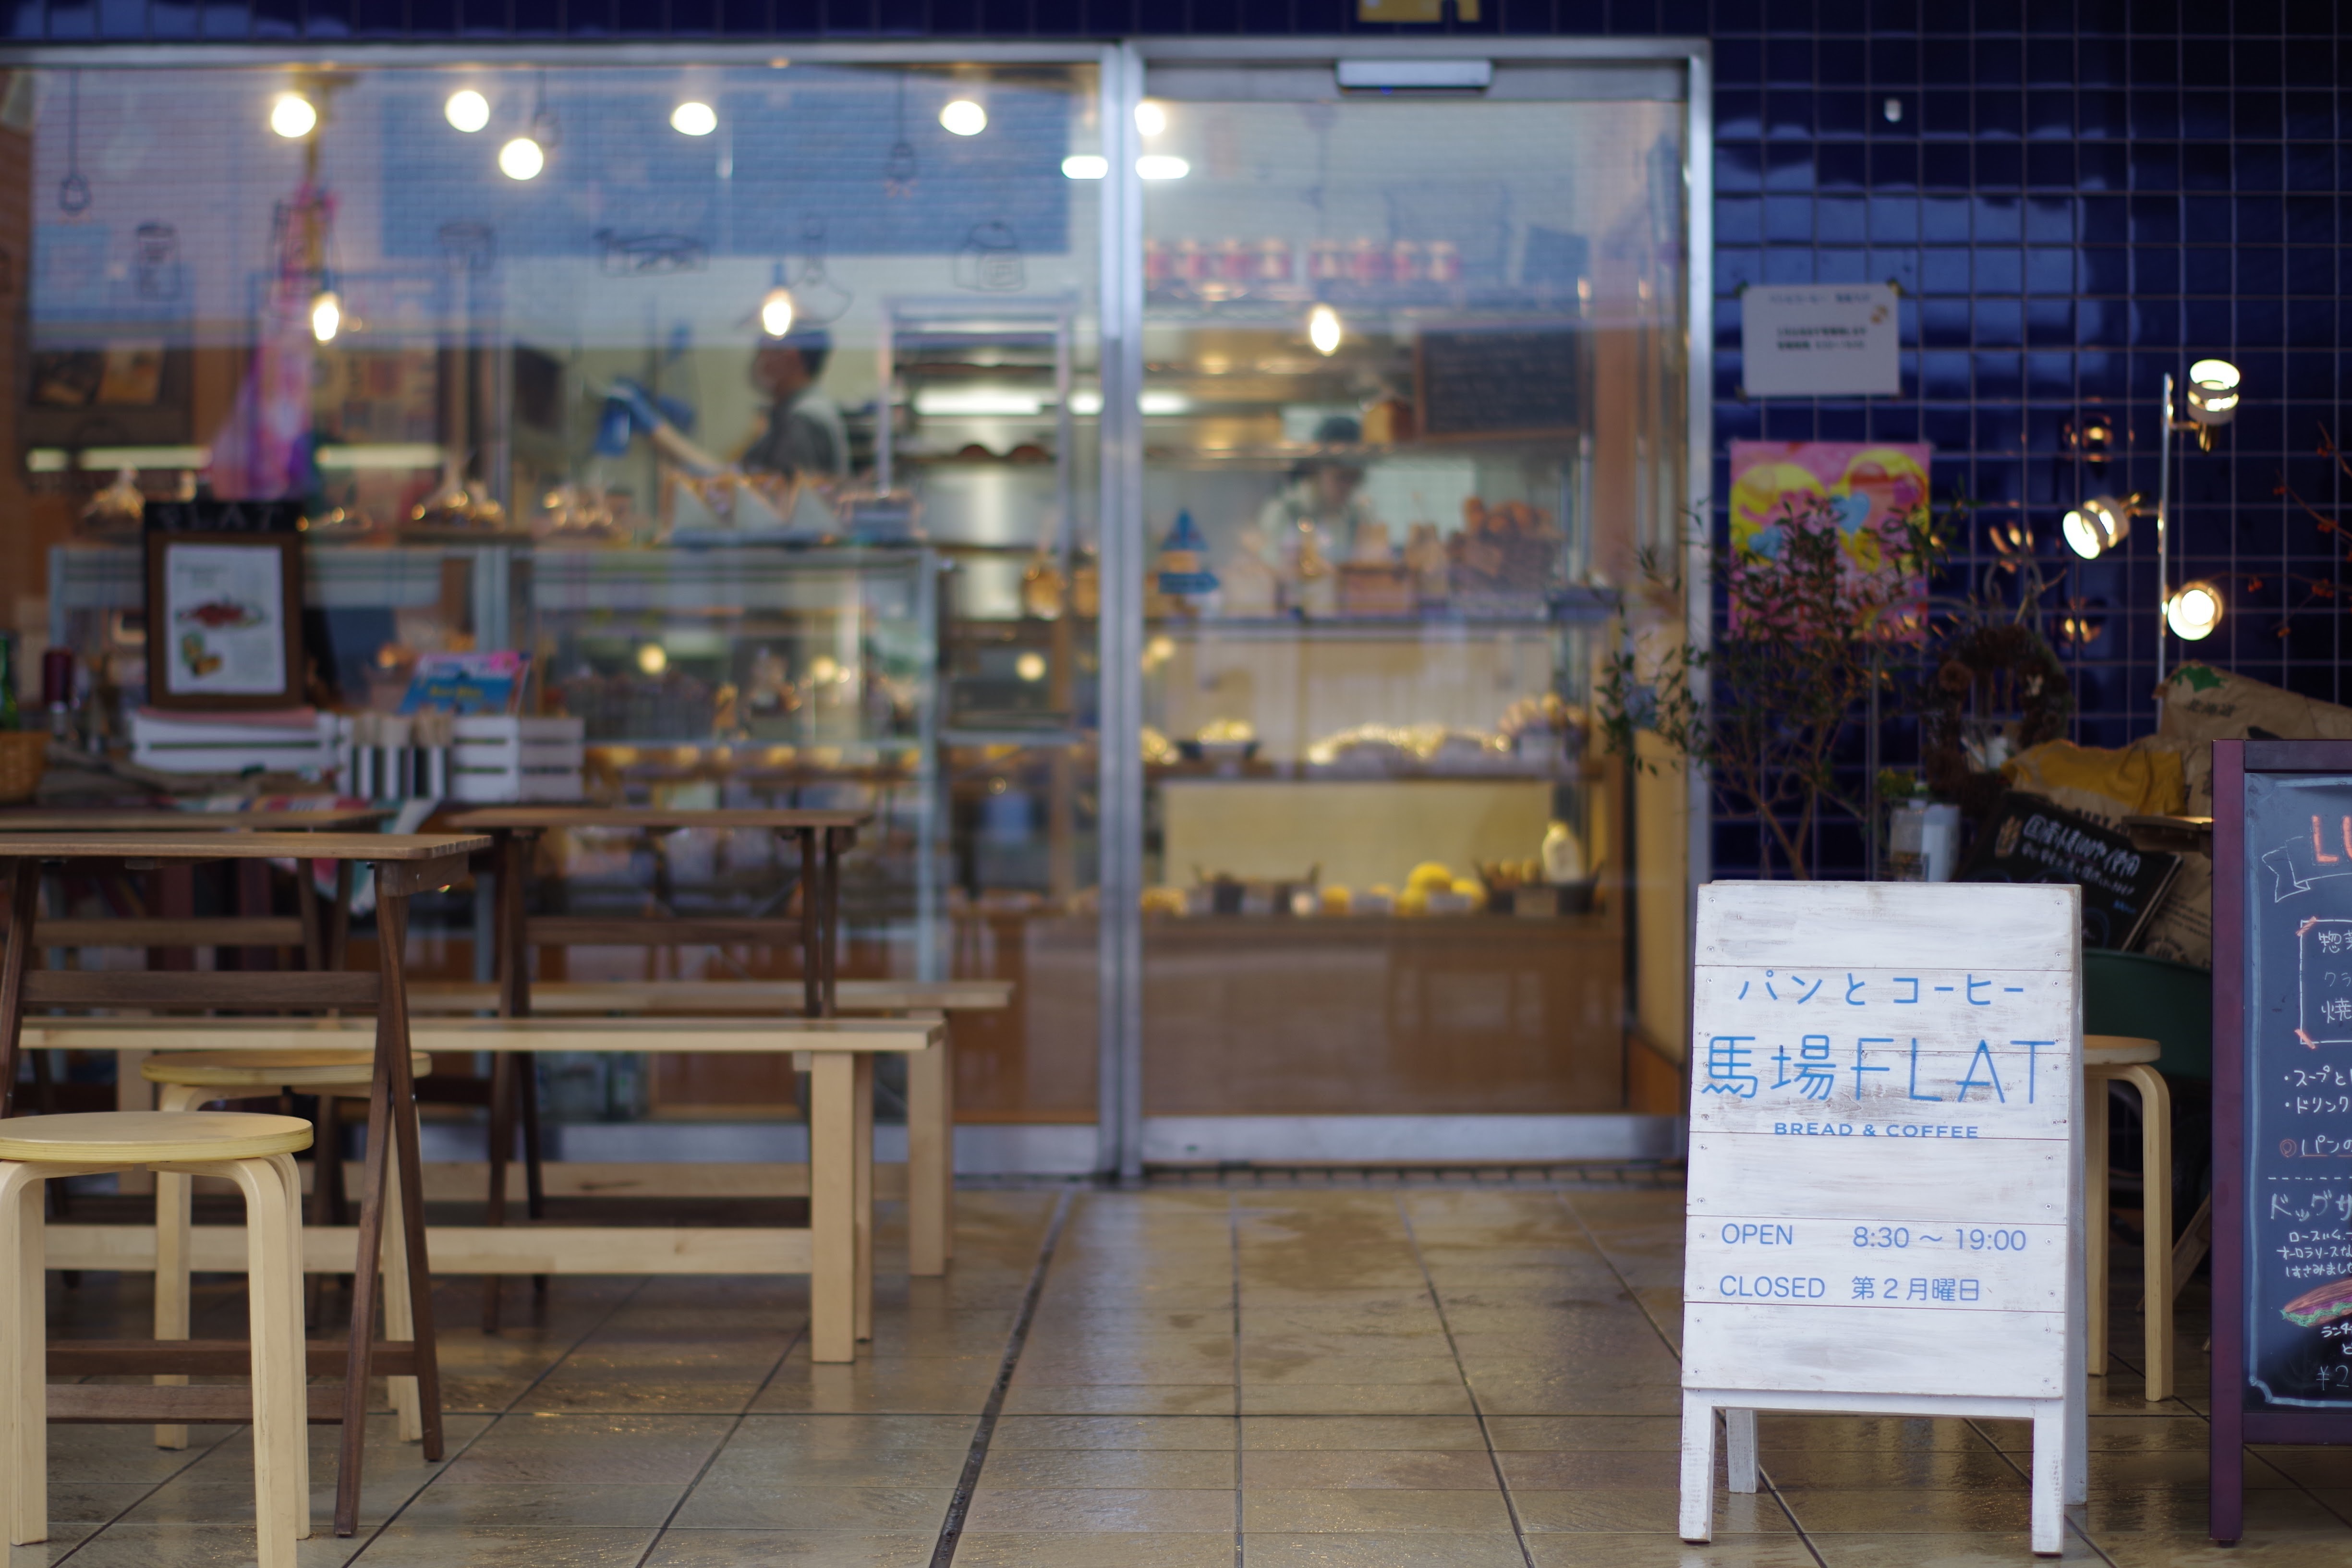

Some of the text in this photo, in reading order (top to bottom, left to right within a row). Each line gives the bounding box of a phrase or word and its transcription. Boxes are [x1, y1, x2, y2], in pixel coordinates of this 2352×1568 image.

[1738, 970, 2025, 1007] パンとコーヒー
[2297, 1096, 2349, 1114] ドリンク
[1774, 1122, 1978, 1140] BREAD & COFFEE
[1722, 1223, 1794, 1245] OPEN
[1853, 1226, 1910, 1249] 8:30
[1956, 1229, 2027, 1252] 19:00
[1720, 1275, 1980, 1302] CLOSED 第2月曜日
